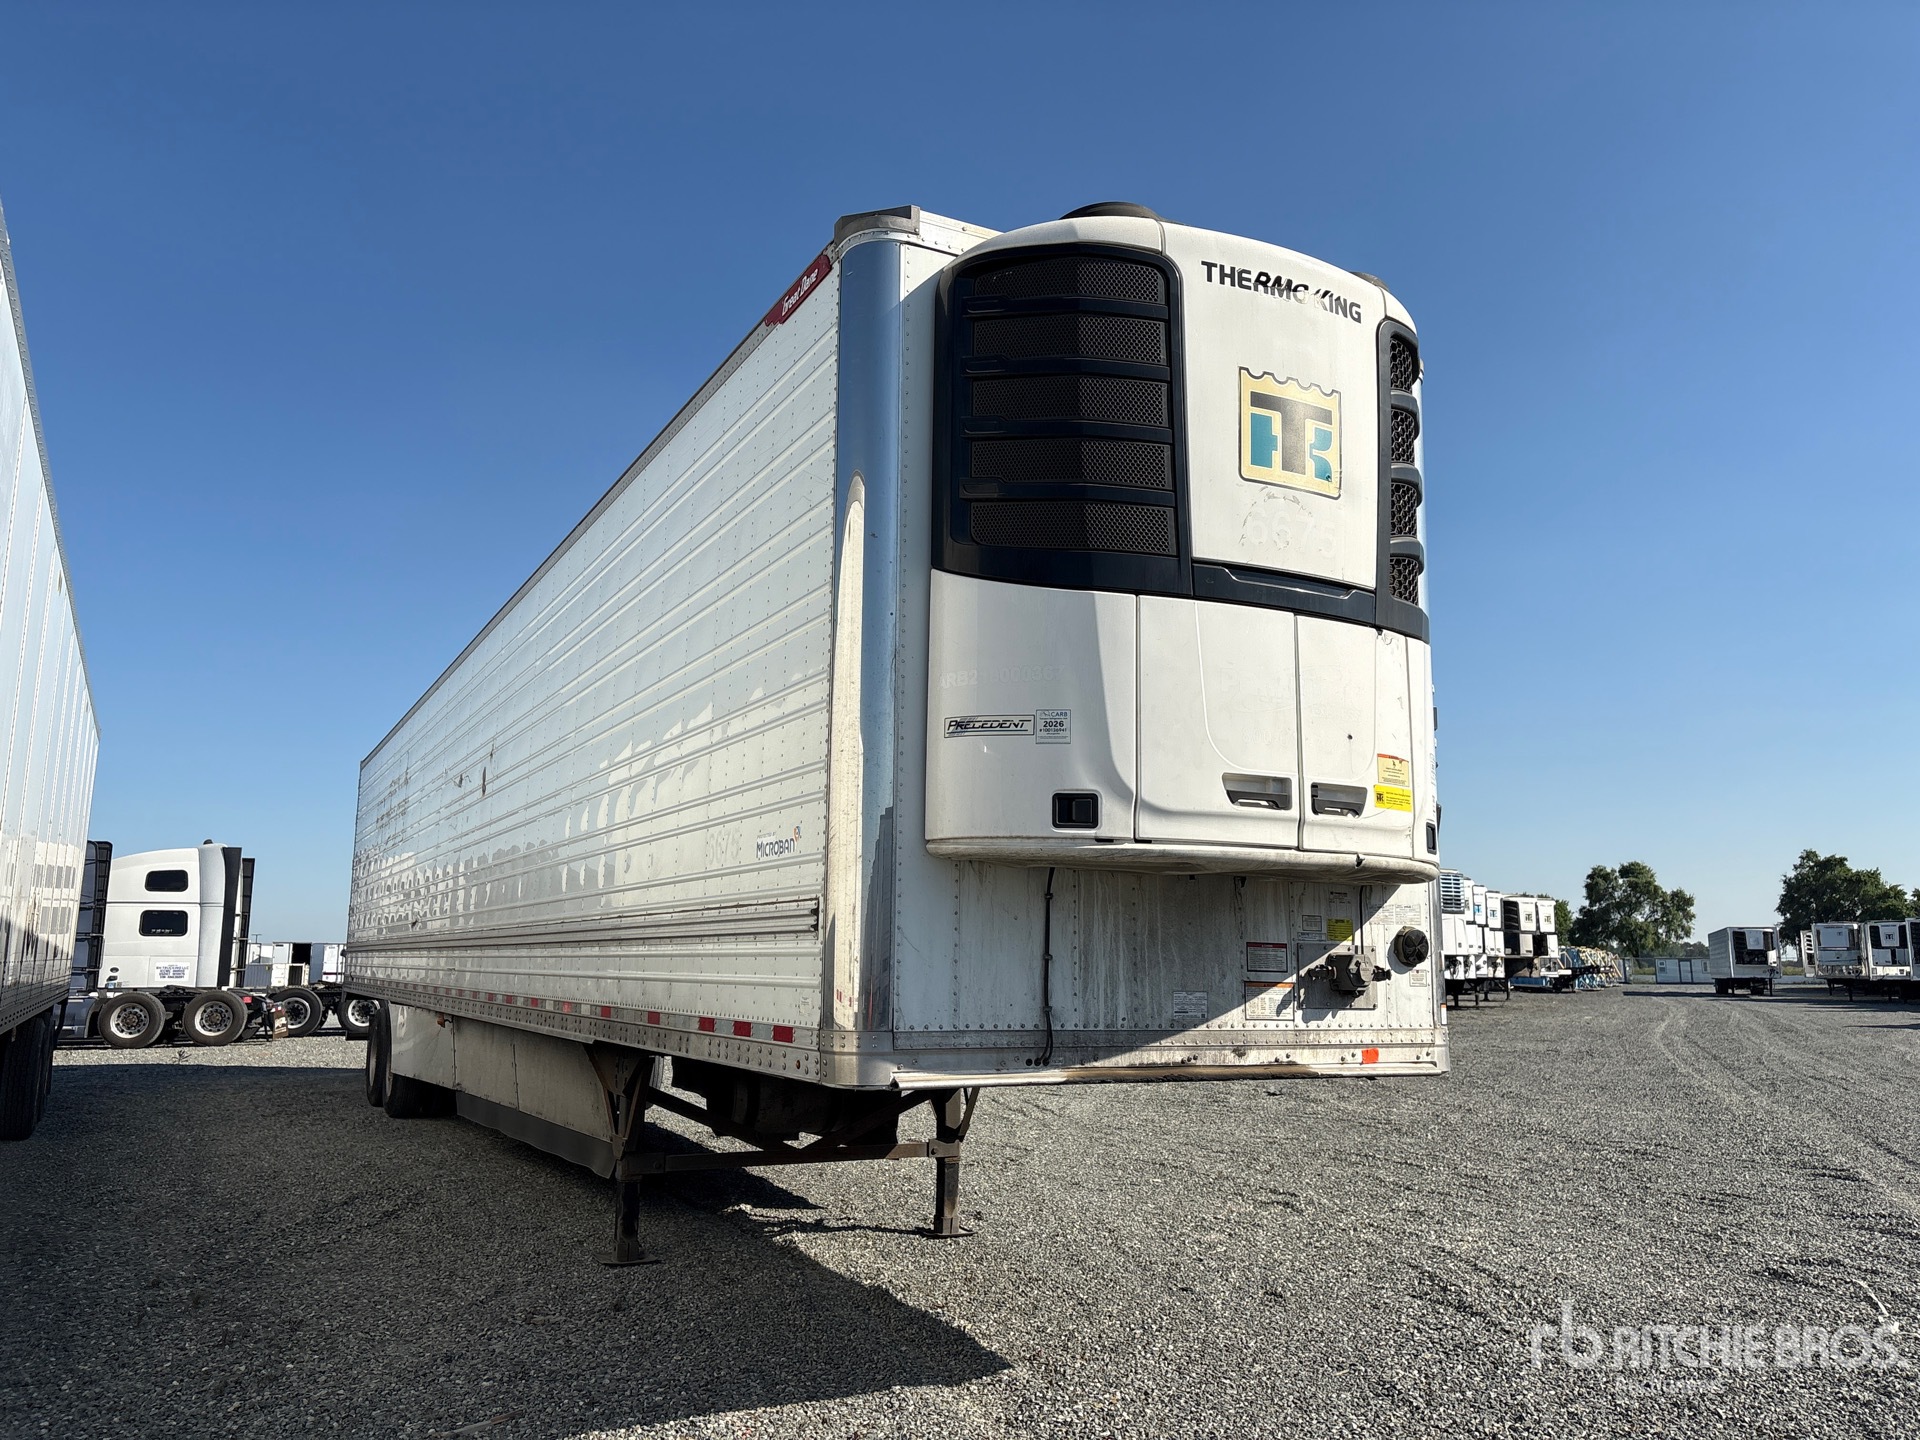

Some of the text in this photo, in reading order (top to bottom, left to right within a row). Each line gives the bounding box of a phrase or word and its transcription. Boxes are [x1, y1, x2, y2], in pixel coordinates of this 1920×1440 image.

[782, 269, 818, 316] Great Dane
[1201, 261, 1362, 324] THERMO KING
[947, 719, 1032, 731] PRECEDENT
[1043, 720, 1064, 728] 2026
[756, 838, 795, 858] MICROBAN
